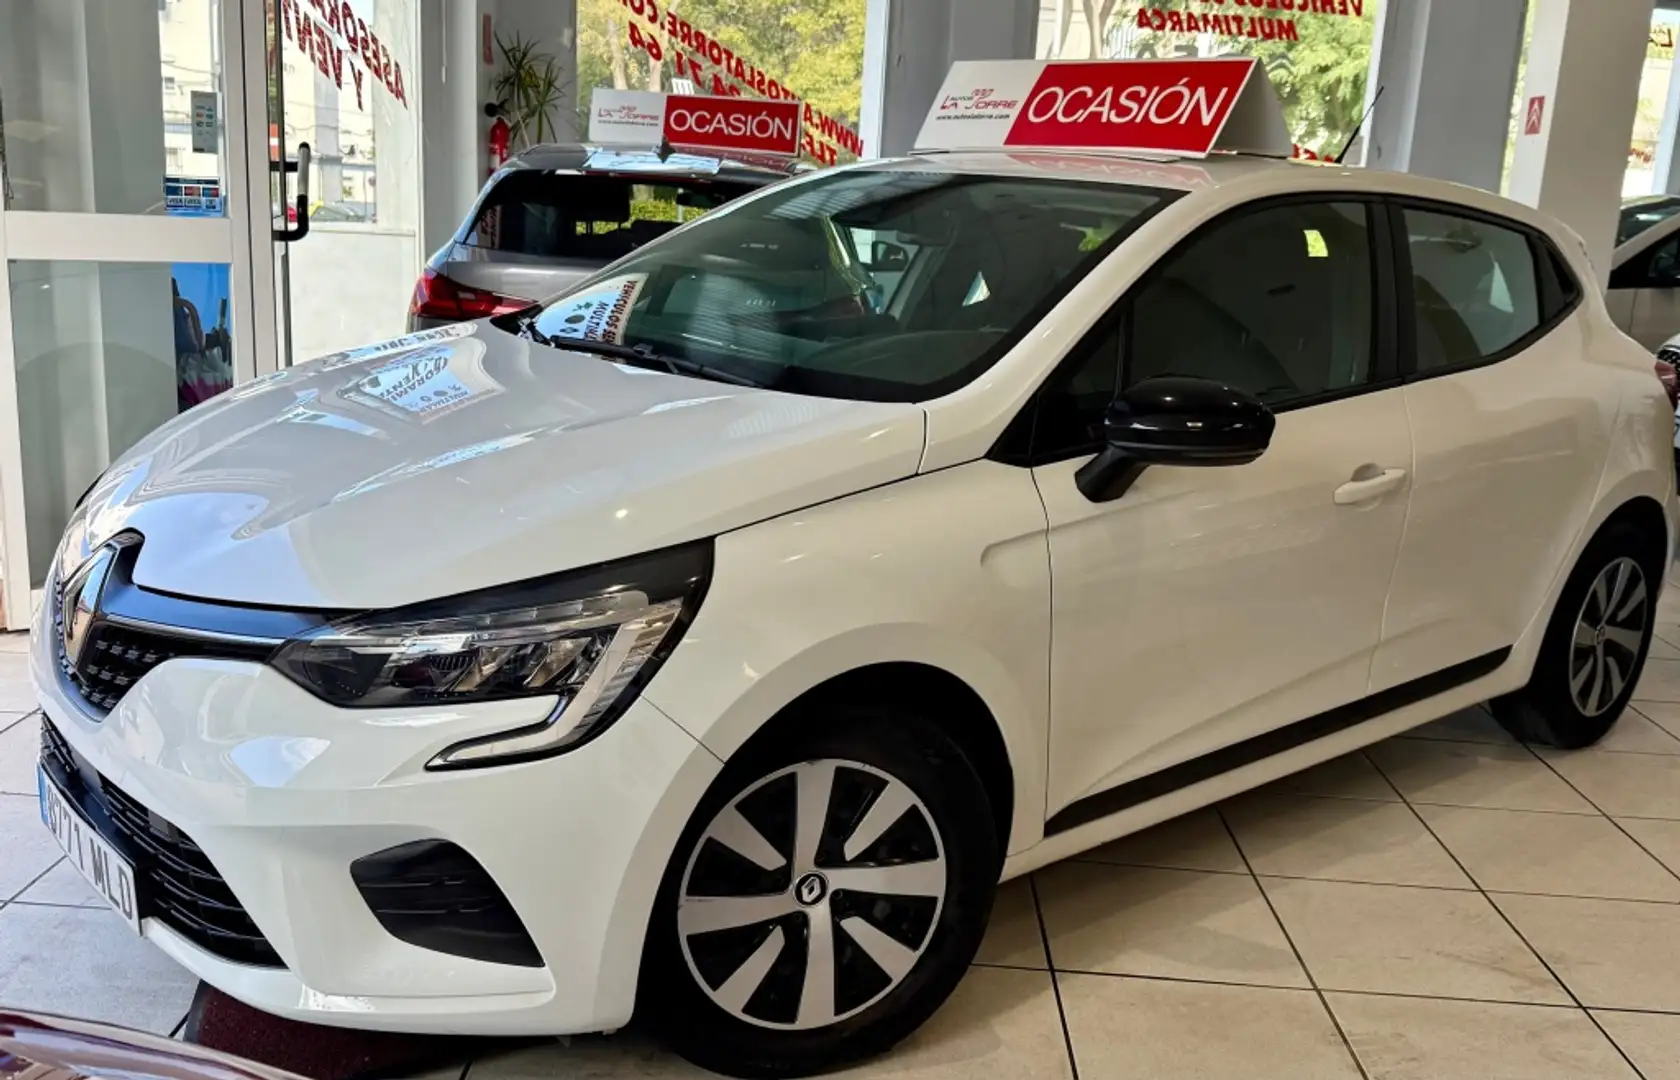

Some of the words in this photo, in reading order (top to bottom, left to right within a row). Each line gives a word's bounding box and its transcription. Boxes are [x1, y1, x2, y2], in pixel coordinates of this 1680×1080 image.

[669, 110, 793, 141] OCASIÓN
[1028, 77, 1227, 126] OCASIÓN
[90, 837, 133, 921] MLD
